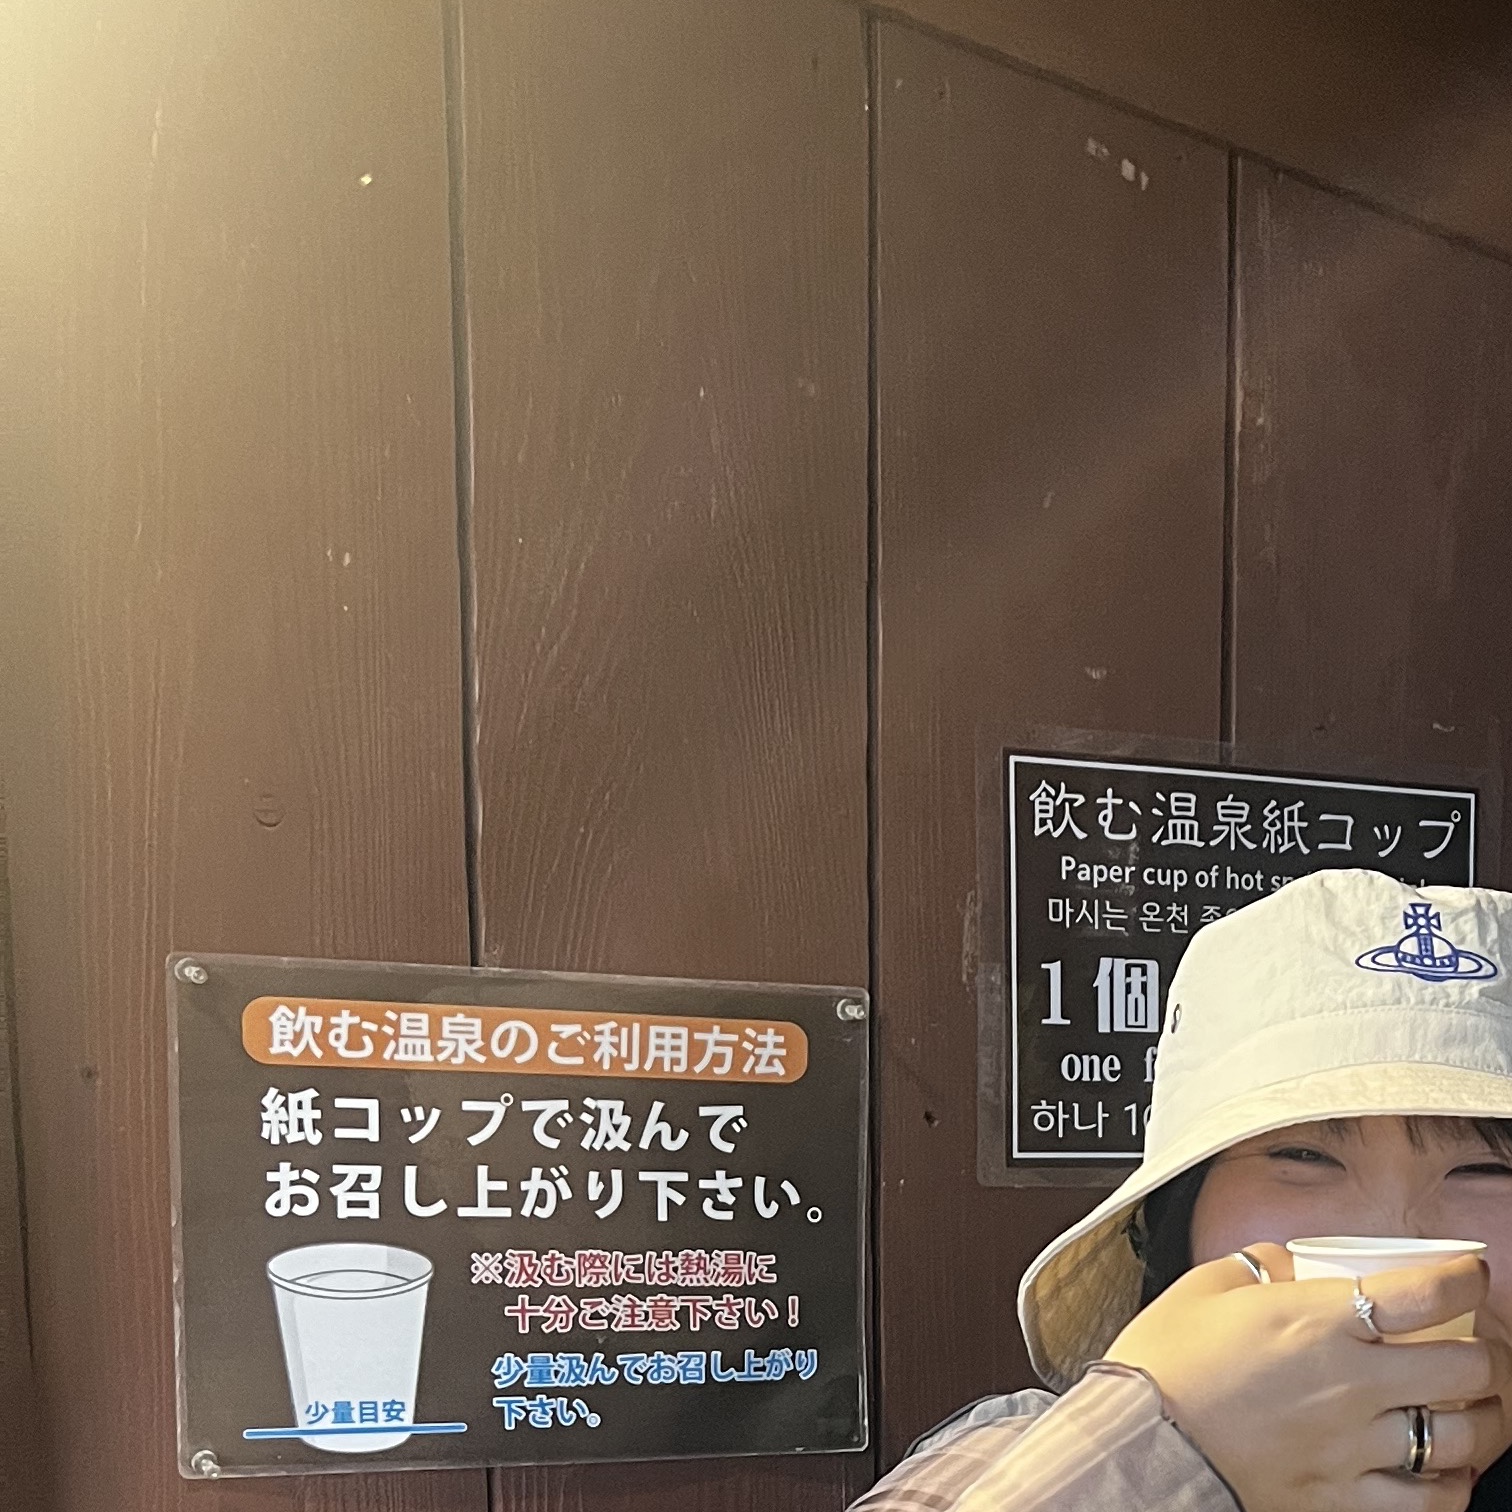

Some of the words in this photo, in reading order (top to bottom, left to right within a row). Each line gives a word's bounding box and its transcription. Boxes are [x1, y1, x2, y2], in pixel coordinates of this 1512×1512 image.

[1028, 779, 1462, 859] 飲む温泉紙コップ
[1060, 856, 1136, 889] Paper
[1143, 867, 1188, 891] cup
[1195, 866, 1219, 889] of
[1226, 867, 1263, 891] hot
[1048, 898, 1129, 932] 마시는
[1139, 901, 1189, 934] 온천
[267, 1004, 787, 1077] 飲む温泉のご利用方法
[1060, 1053, 1122, 1083] one
[260, 1086, 748, 1153] 紙コップで汲んで
[1030, 1099, 1110, 1138] 하나
[264, 1161, 823, 1225] お召し上がり下さい。
[470, 1249, 777, 1288] ※汲む際には熱湯に
[505, 1294, 799, 1333] 十分ご注意下さい！
[491, 1348, 818, 1389] 少量汲んでお召し上がり
[305, 1398, 406, 1425] 少量目安
[492, 1395, 602, 1430] 下さい。
